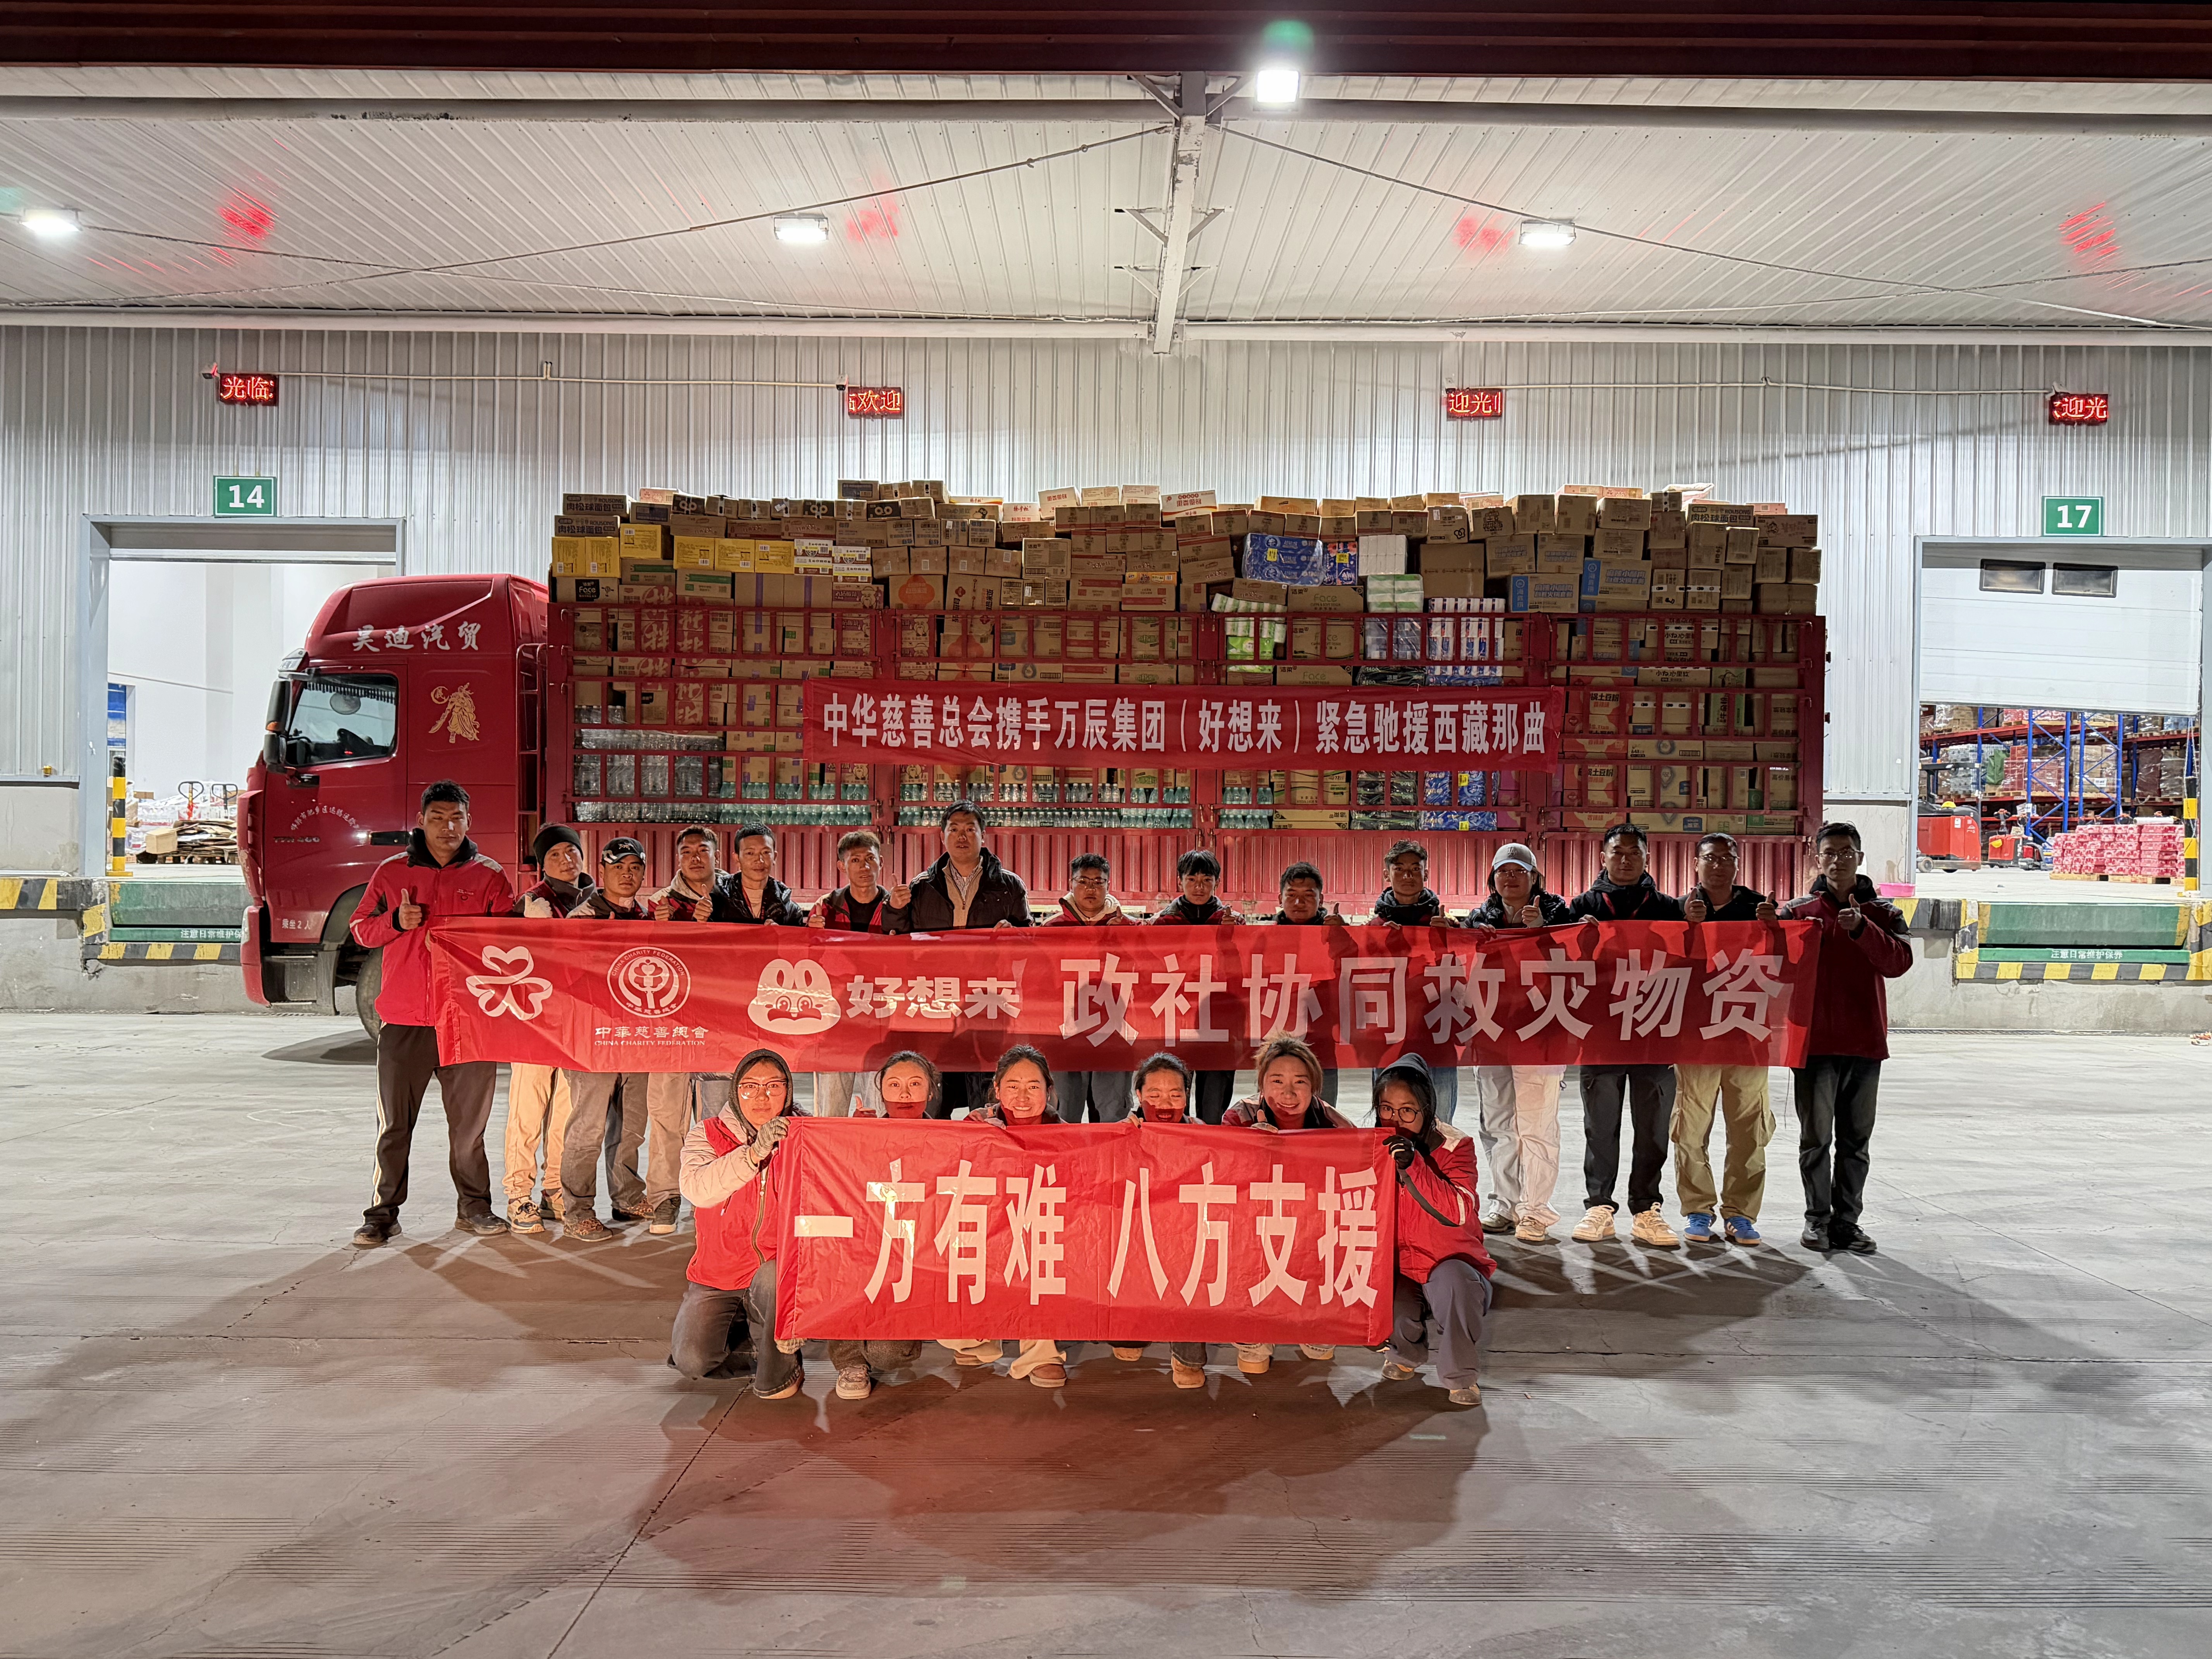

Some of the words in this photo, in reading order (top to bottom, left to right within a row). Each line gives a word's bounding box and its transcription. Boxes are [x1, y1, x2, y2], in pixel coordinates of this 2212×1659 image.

[220, 376, 274, 400] 光临
[1449, 392, 1501, 414] 迎光
[2054, 397, 2107, 419] 迎光
[229, 485, 264, 508] 14
[567, 503, 611, 512] 肉松球面包
[1691, 514, 1737, 522] 肉松球面包
[2057, 505, 2092, 528] 17
[558, 525, 603, 534] 肉松球面包
[1314, 593, 1338, 602] Face
[1303, 672, 1326, 680] Face
[611, 960, 625, 977] CHINA
[624, 949, 651, 960] CHARITY
[653, 950, 685, 977] FEDERATION
[2051, 950, 2123, 959] 注意日常维护保养
[846, 974, 1021, 1020] 好想来
[1060, 947, 1784, 1048] 政社协同救灾物资
[595, 1026, 709, 1039] 中華慈善總會
[794, 1158, 1067, 1306] 一方有难
[1107, 1160, 1379, 1309] 八方支援
